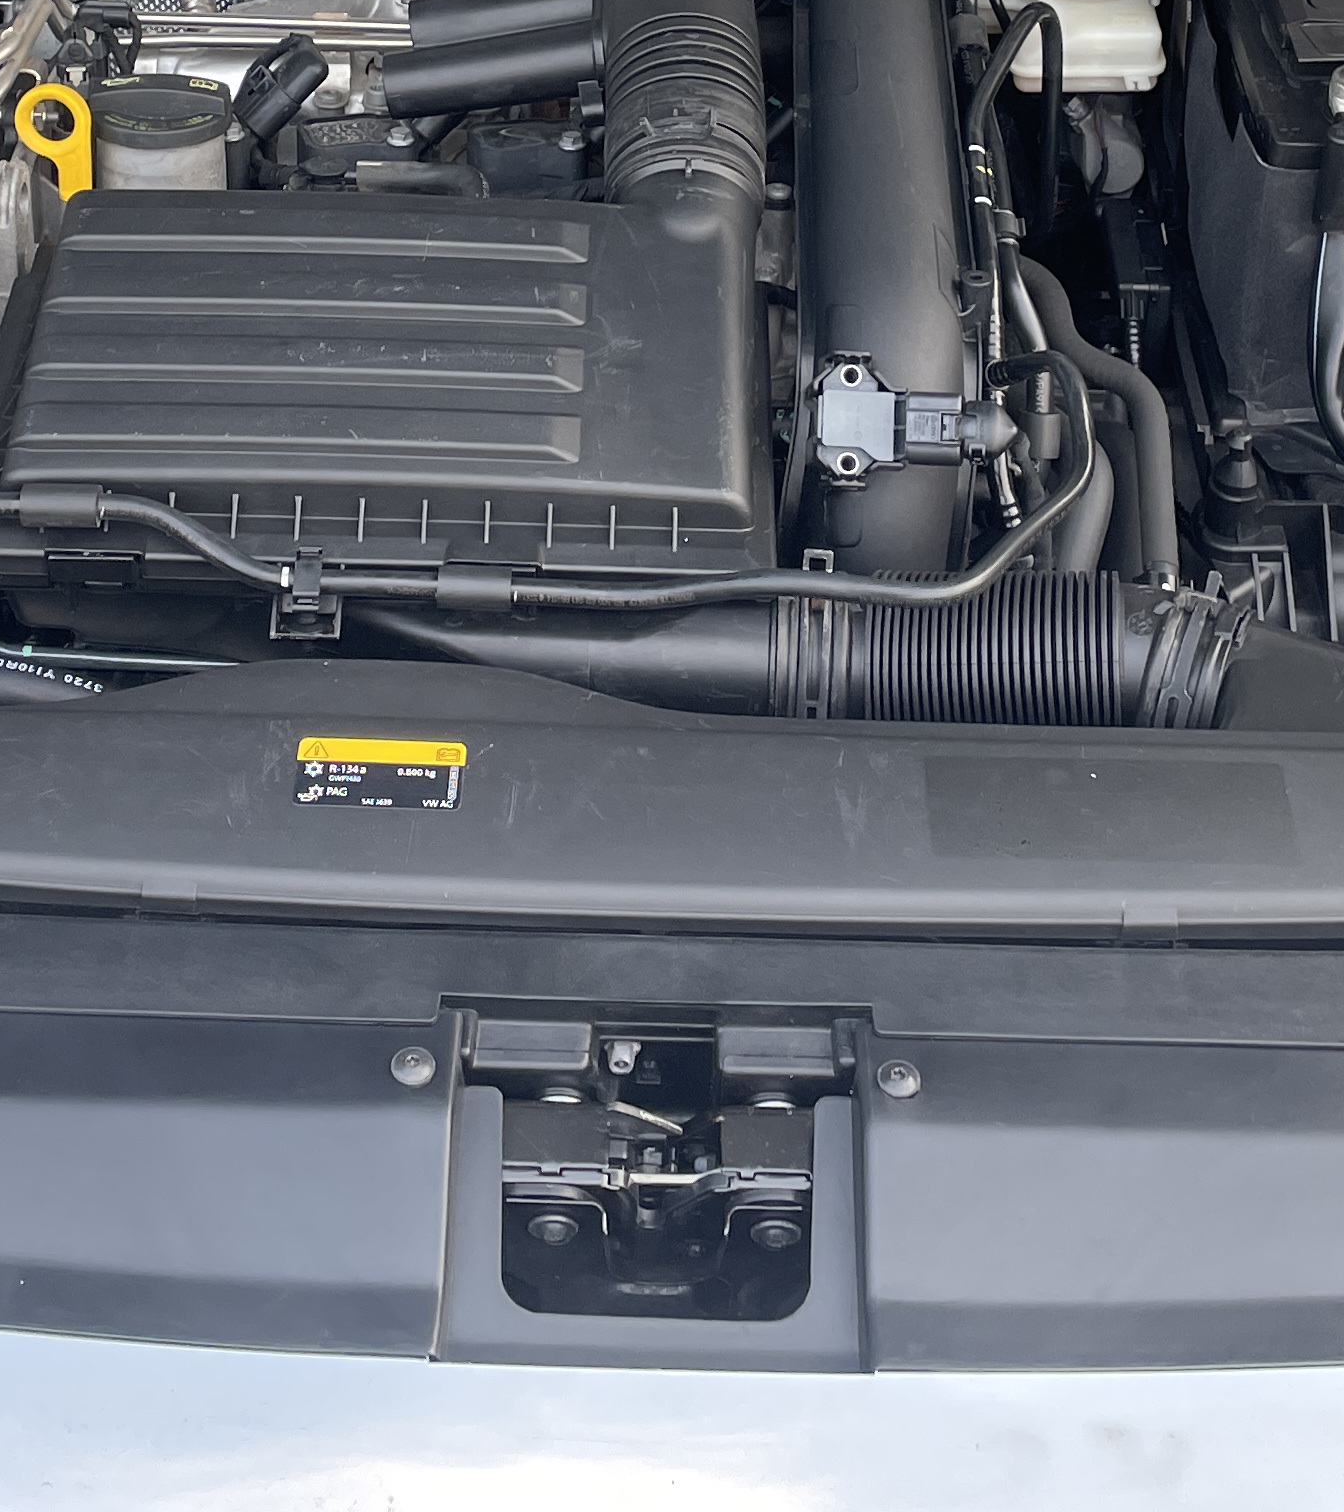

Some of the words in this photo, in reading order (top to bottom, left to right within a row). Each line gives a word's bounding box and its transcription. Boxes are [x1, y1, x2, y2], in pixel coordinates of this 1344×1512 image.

[424, 768, 436, 779] kg
[326, 786, 348, 797] PAG
[422, 799, 440, 808] VW
[440, 799, 454, 809] AG
